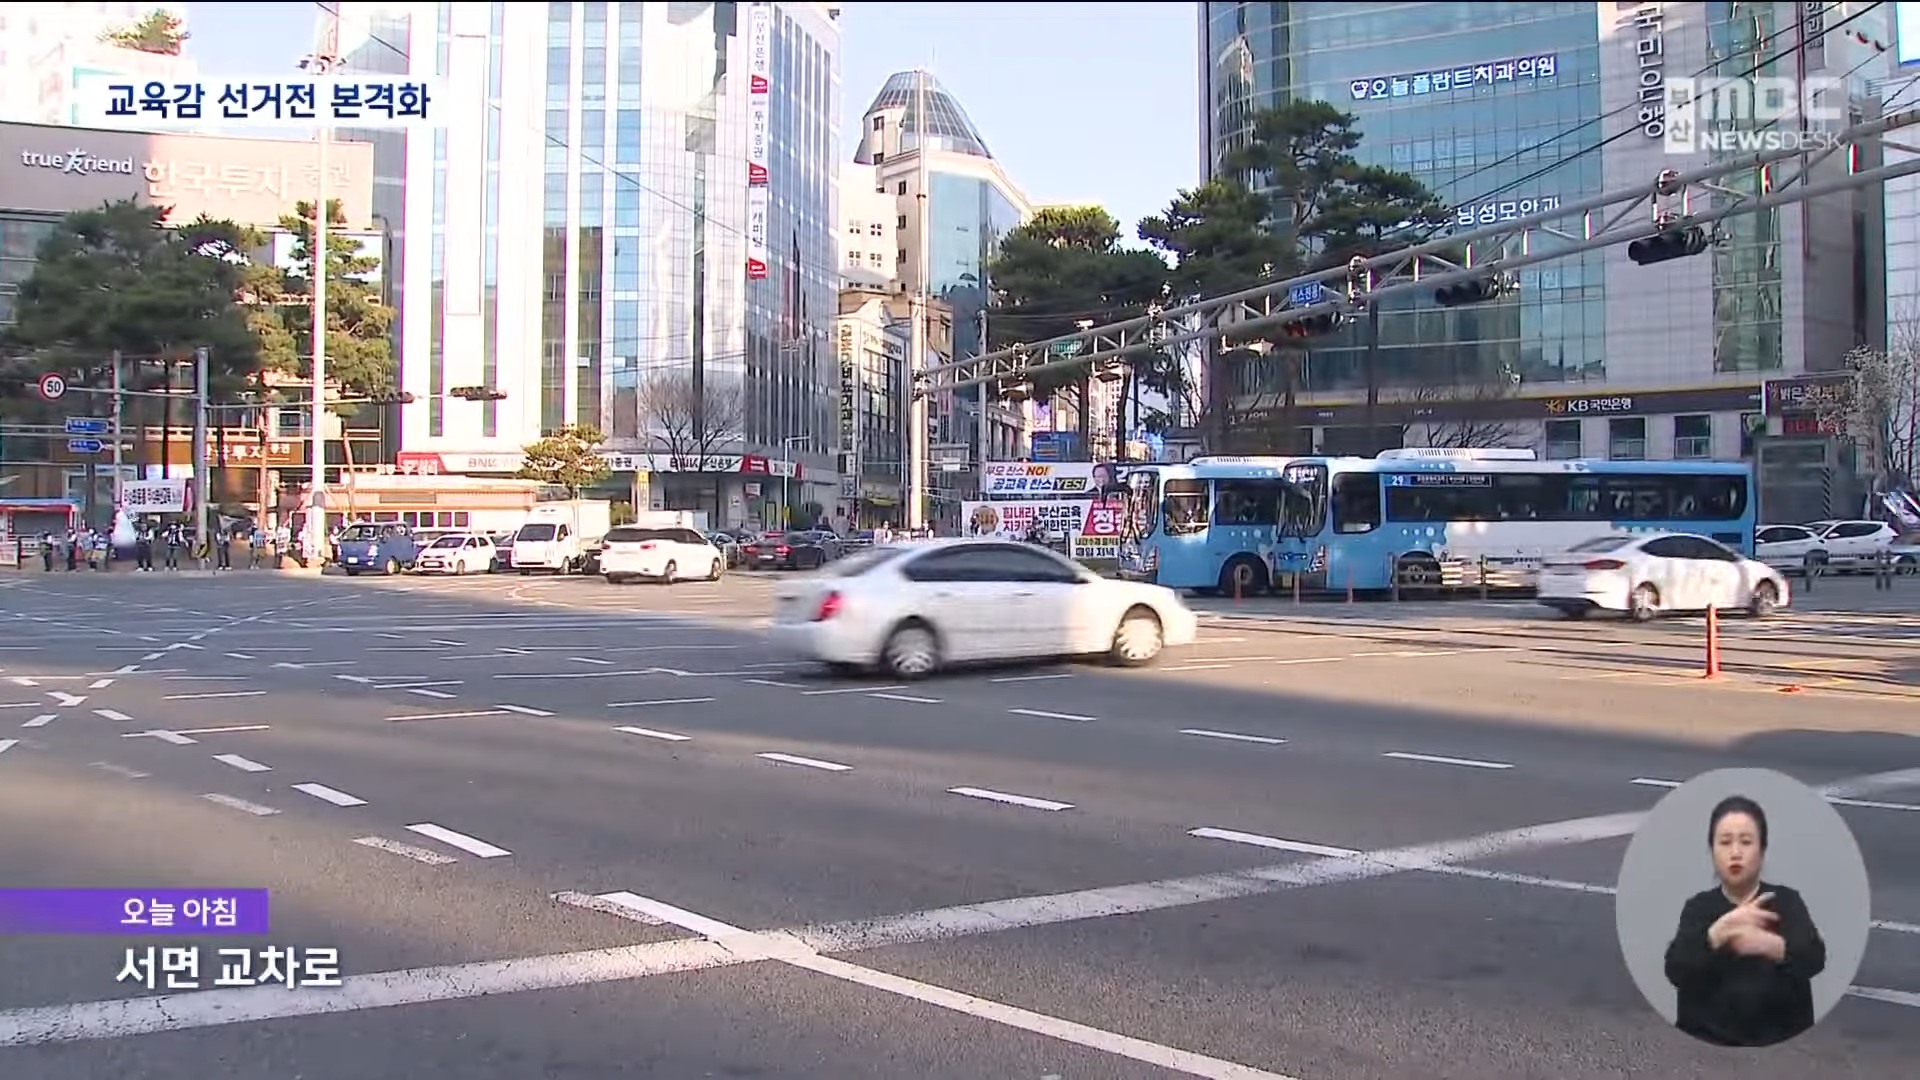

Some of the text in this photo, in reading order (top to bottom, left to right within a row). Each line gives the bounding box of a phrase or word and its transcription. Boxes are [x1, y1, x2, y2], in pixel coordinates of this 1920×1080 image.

[1370, 56, 1555, 99] 오늘플란트치과의원
[142, 158, 293, 200] 한국투자
[47, 381, 60, 392] 50
[1006, 466, 1025, 476] 찬스
[1026, 466, 1049, 476] NO!
[993, 478, 1085, 490] 공교육 찬스 YES!
[1392, 476, 1403, 486] 29
[1002, 506, 1081, 519] 힘내라 부산교육
